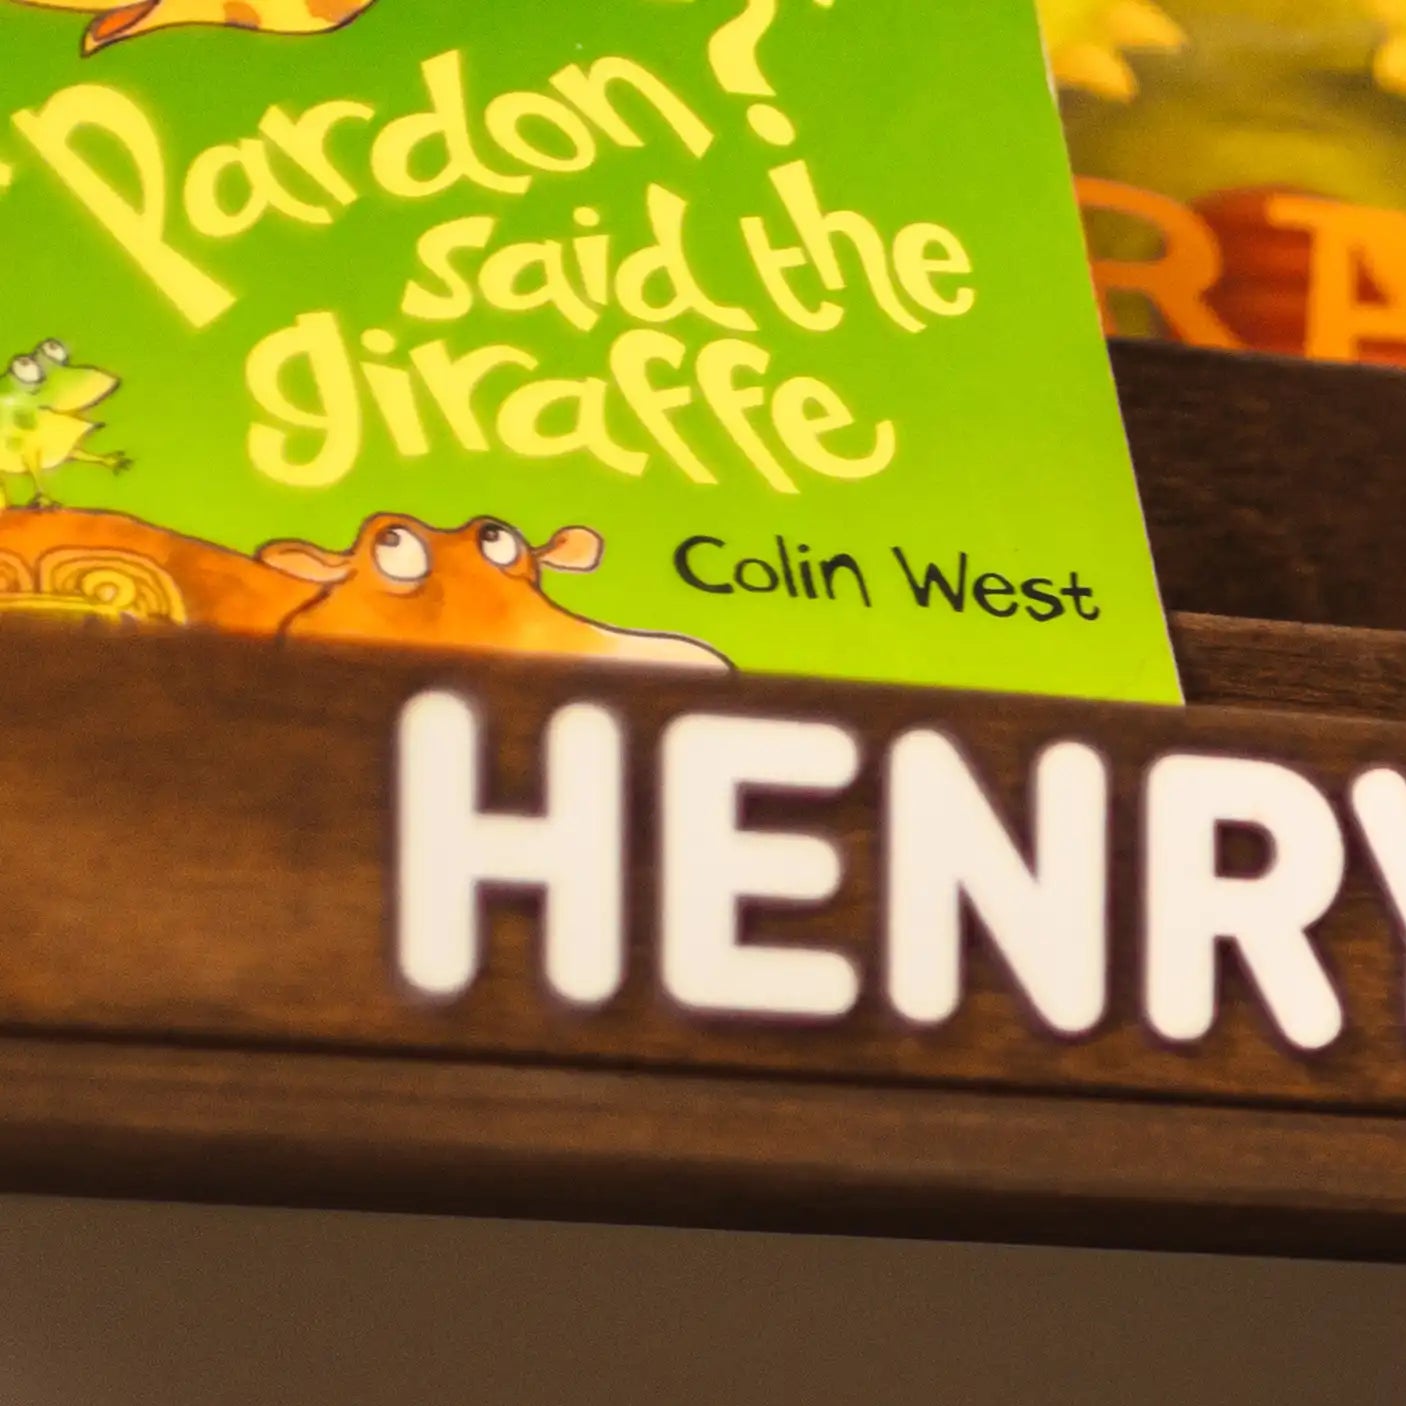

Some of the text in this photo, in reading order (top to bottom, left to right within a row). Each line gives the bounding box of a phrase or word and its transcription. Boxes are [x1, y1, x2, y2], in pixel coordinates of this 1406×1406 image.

[401, 159, 975, 333] said the
[245, 311, 896, 494] giraffe
[674, 534, 1100, 622] Colin West
